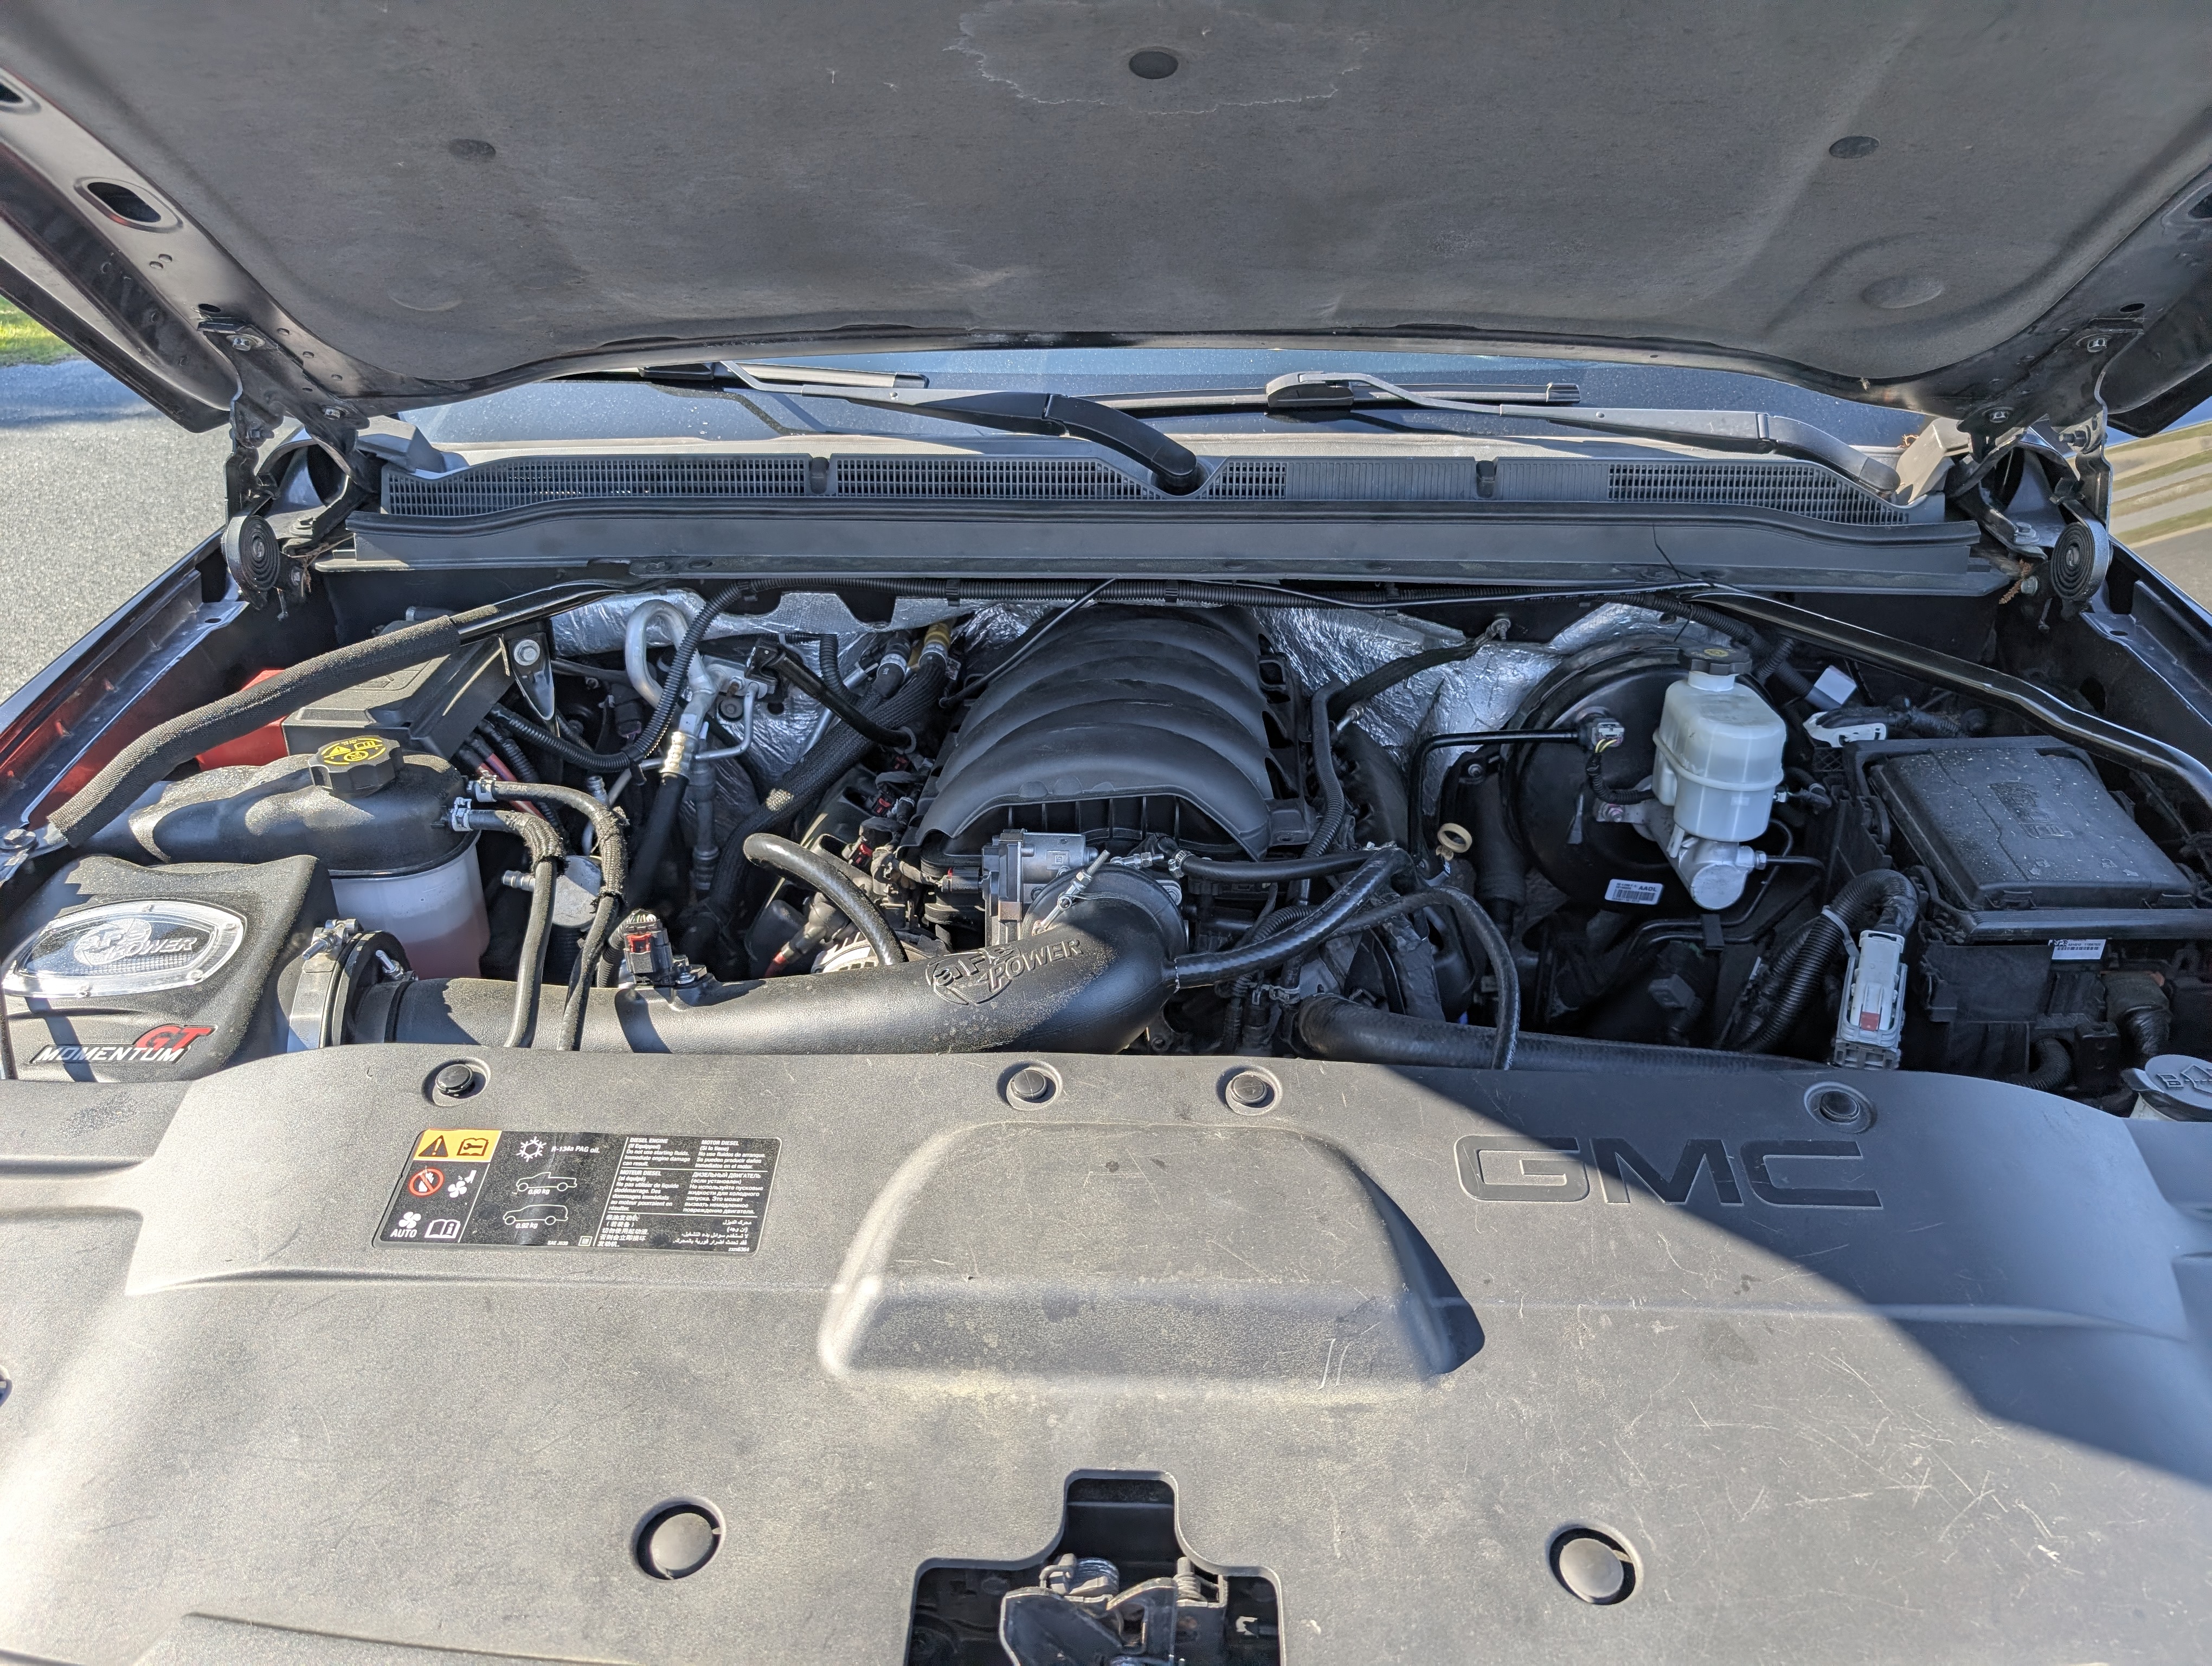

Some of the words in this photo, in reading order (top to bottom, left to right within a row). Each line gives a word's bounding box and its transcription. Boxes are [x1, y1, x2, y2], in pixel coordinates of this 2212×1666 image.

[988, 939, 1083, 992] POWER
[135, 1024, 213, 1053] GT
[36, 1047, 185, 1061] MOMENTUM
[1454, 1135, 1883, 1209] GMC
[390, 1228, 417, 1238] AUTO
